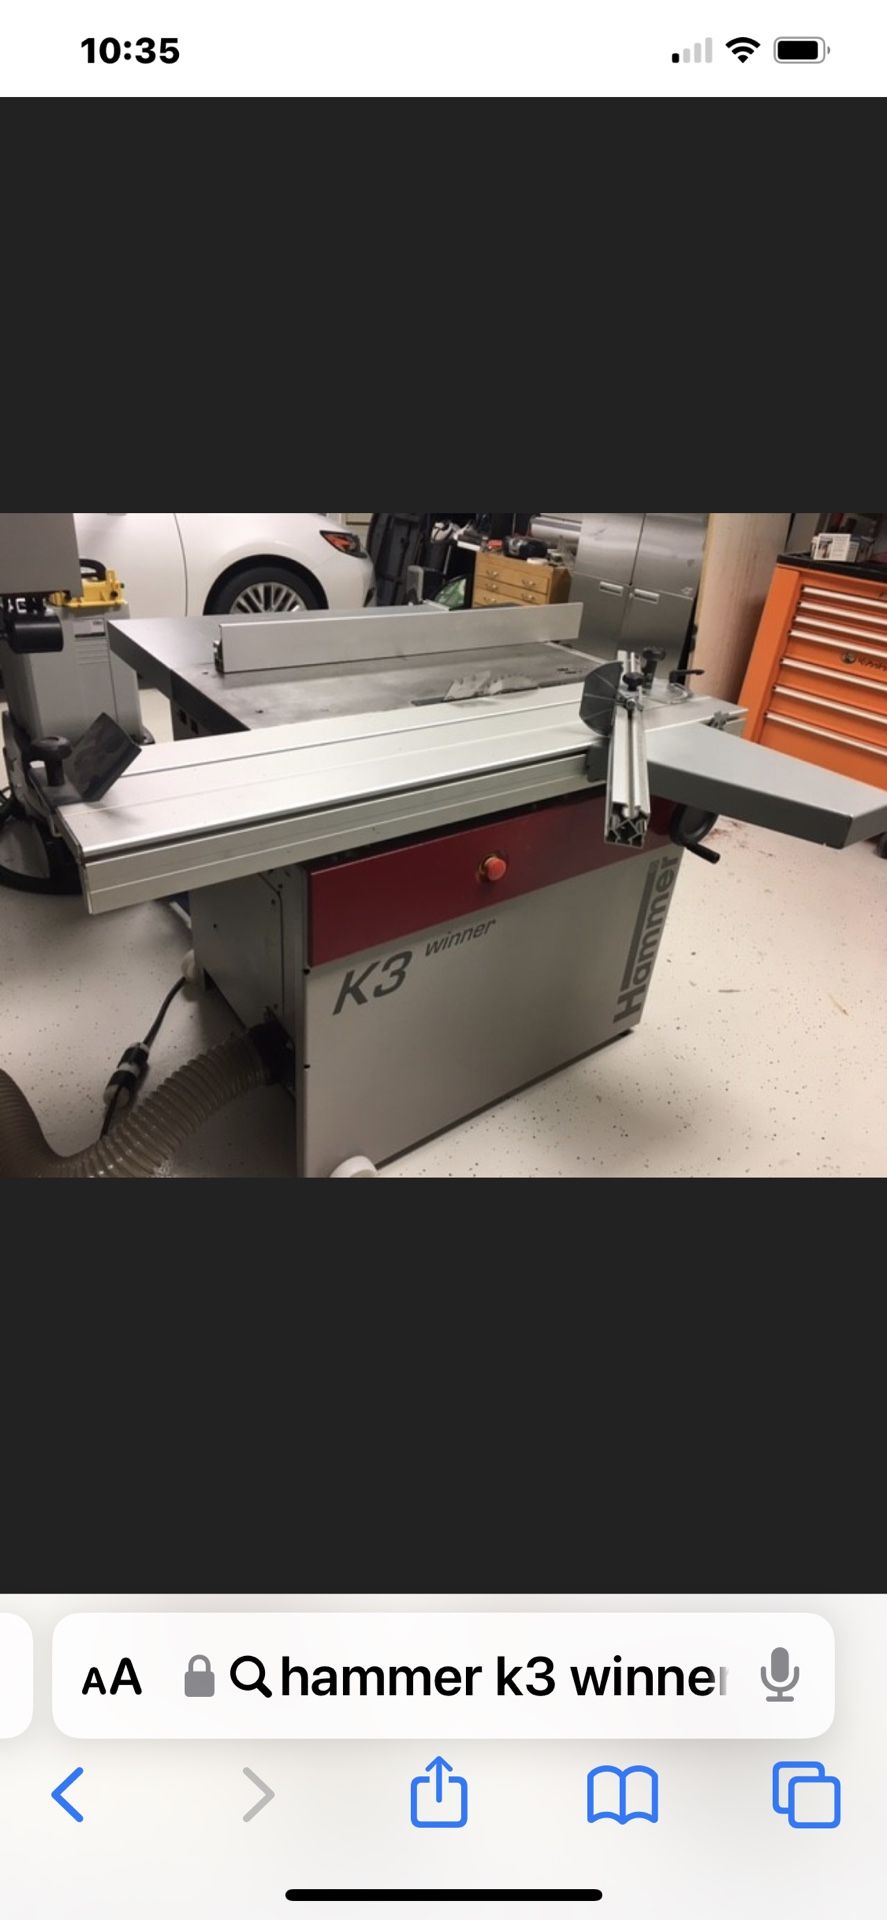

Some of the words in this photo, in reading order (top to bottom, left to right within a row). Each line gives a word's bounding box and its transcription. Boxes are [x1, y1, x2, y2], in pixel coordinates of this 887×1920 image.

[332, 950, 413, 1016] K3
[425, 918, 497, 957] winner
[612, 856, 680, 1024] Hammer
